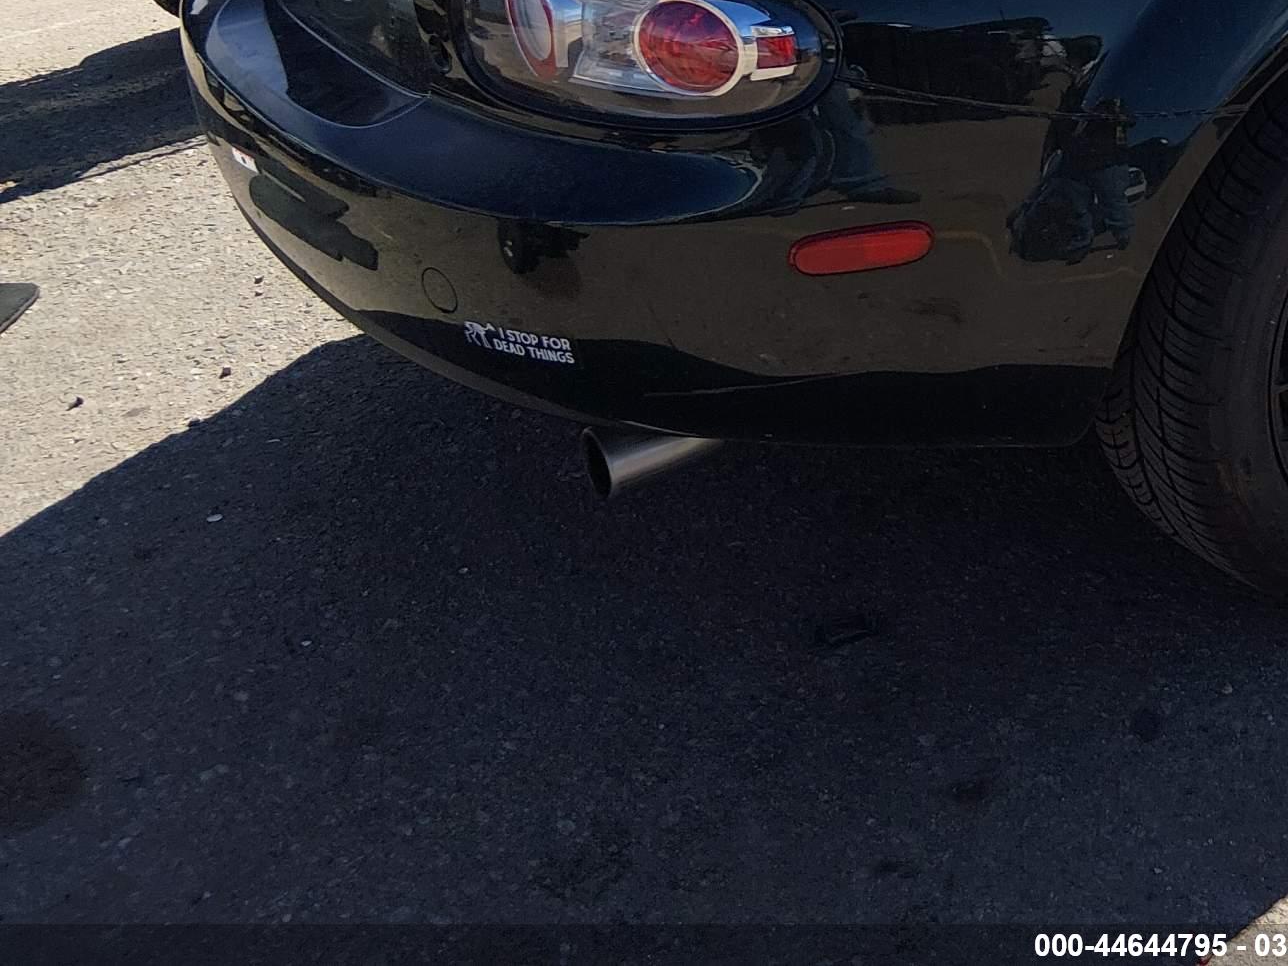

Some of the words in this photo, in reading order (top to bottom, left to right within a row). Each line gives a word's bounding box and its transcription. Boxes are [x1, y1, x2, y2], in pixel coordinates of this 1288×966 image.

[493, 338, 526, 356] DEAD
[526, 346, 575, 364] THINGS
[499, 327, 505, 339] I
[505, 329, 539, 346] STOP
[541, 336, 572, 351] FOR
